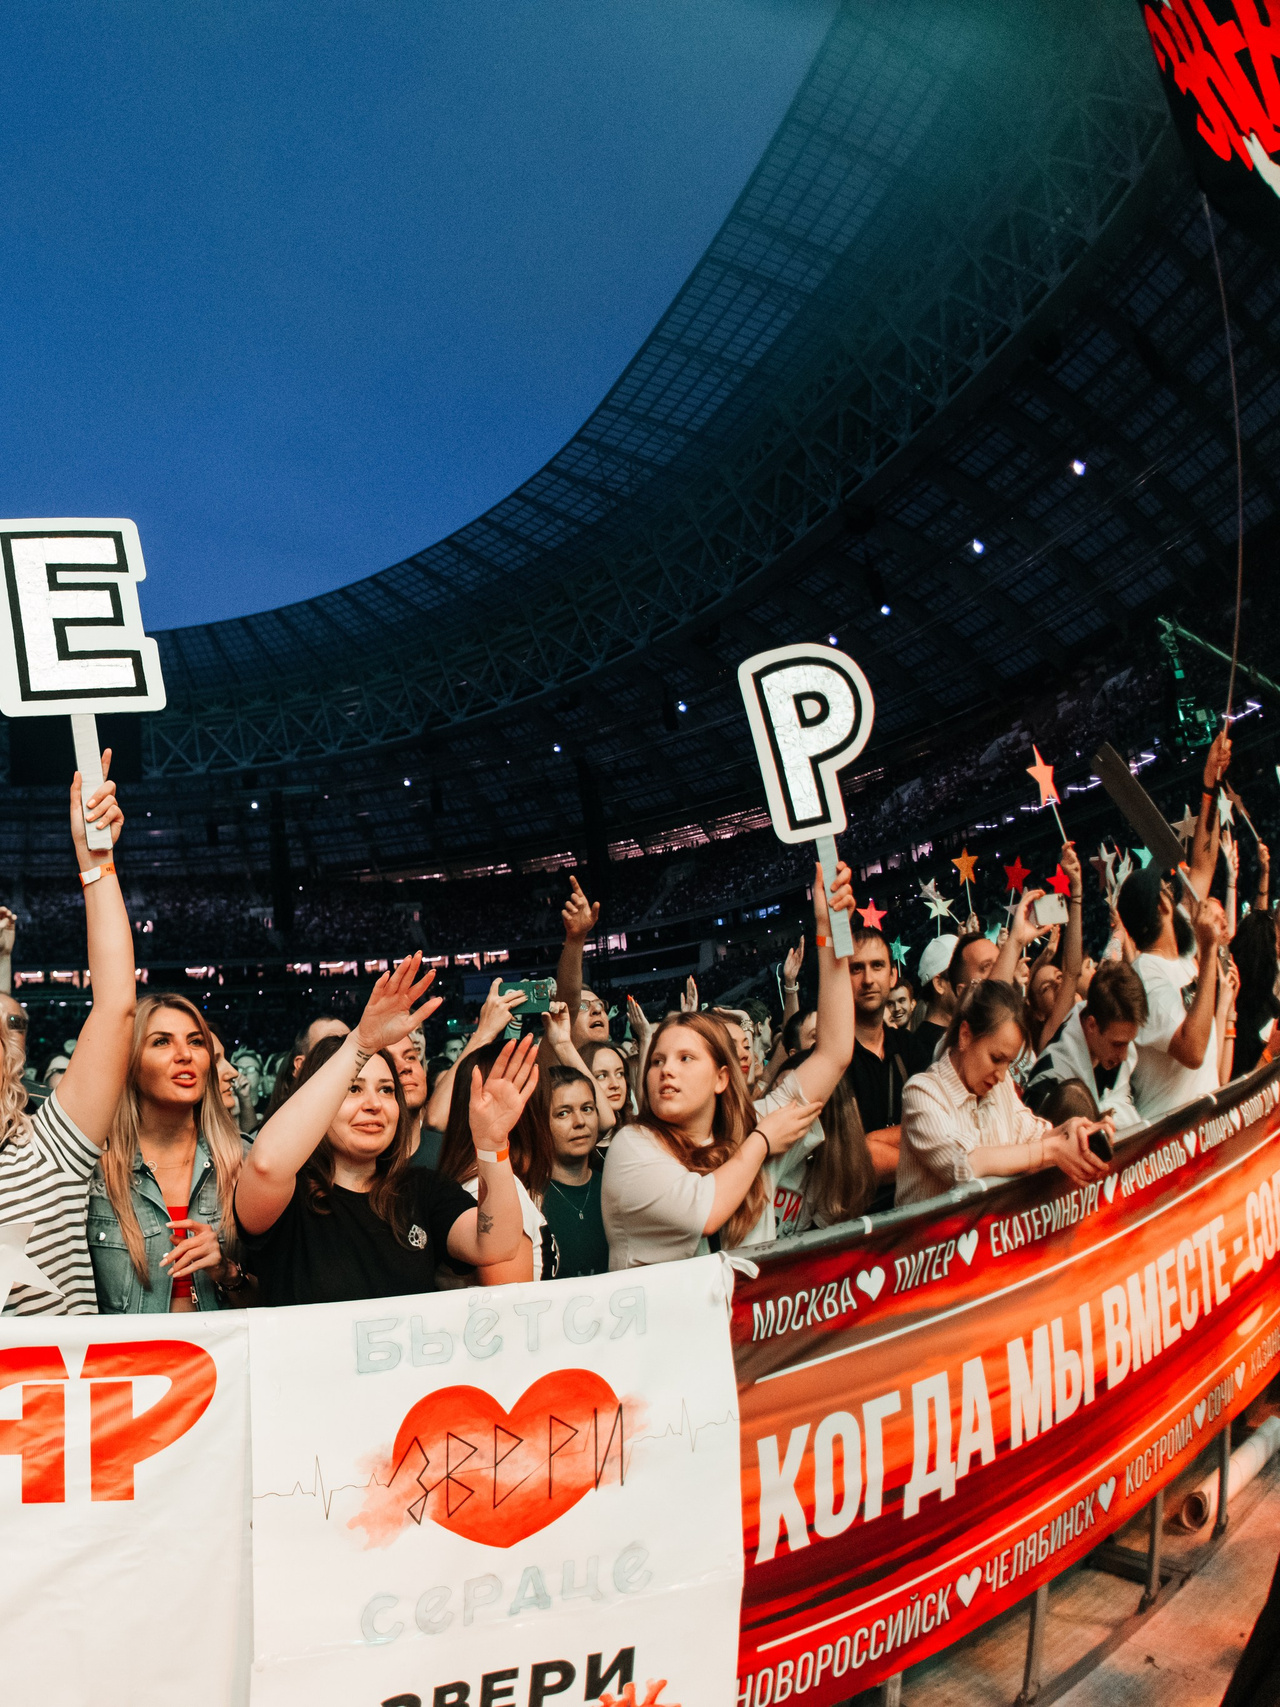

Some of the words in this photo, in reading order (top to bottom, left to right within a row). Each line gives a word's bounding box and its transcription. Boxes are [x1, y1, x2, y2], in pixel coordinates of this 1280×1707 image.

[0, 530, 149, 702] Е
[751, 656, 863, 832] Р
[752, 1277, 858, 1342] МОСКВА
[893, 1239, 956, 1294] ПИТЕР
[990, 1180, 1104, 1257] ЕКАТЕРИНБУРГ
[1120, 1139, 1187, 1198] ЯРОСЛАВЛЬ
[1198, 1113, 1235, 1154] САМАРА
[754, 1356, 996, 1565] КОГДА
[1006, 1302, 1096, 1451] МЫ
[1101, 1214, 1231, 1391] ВМЕСТЕ
[736, 1583, 952, 1707] НОВОРОССИЙСК
[985, 1490, 1096, 1593] ЧЕЛЯБИНСК
[1125, 1412, 1193, 1498] КОСТРОМА
[1207, 1373, 1235, 1424] СОЧИ
